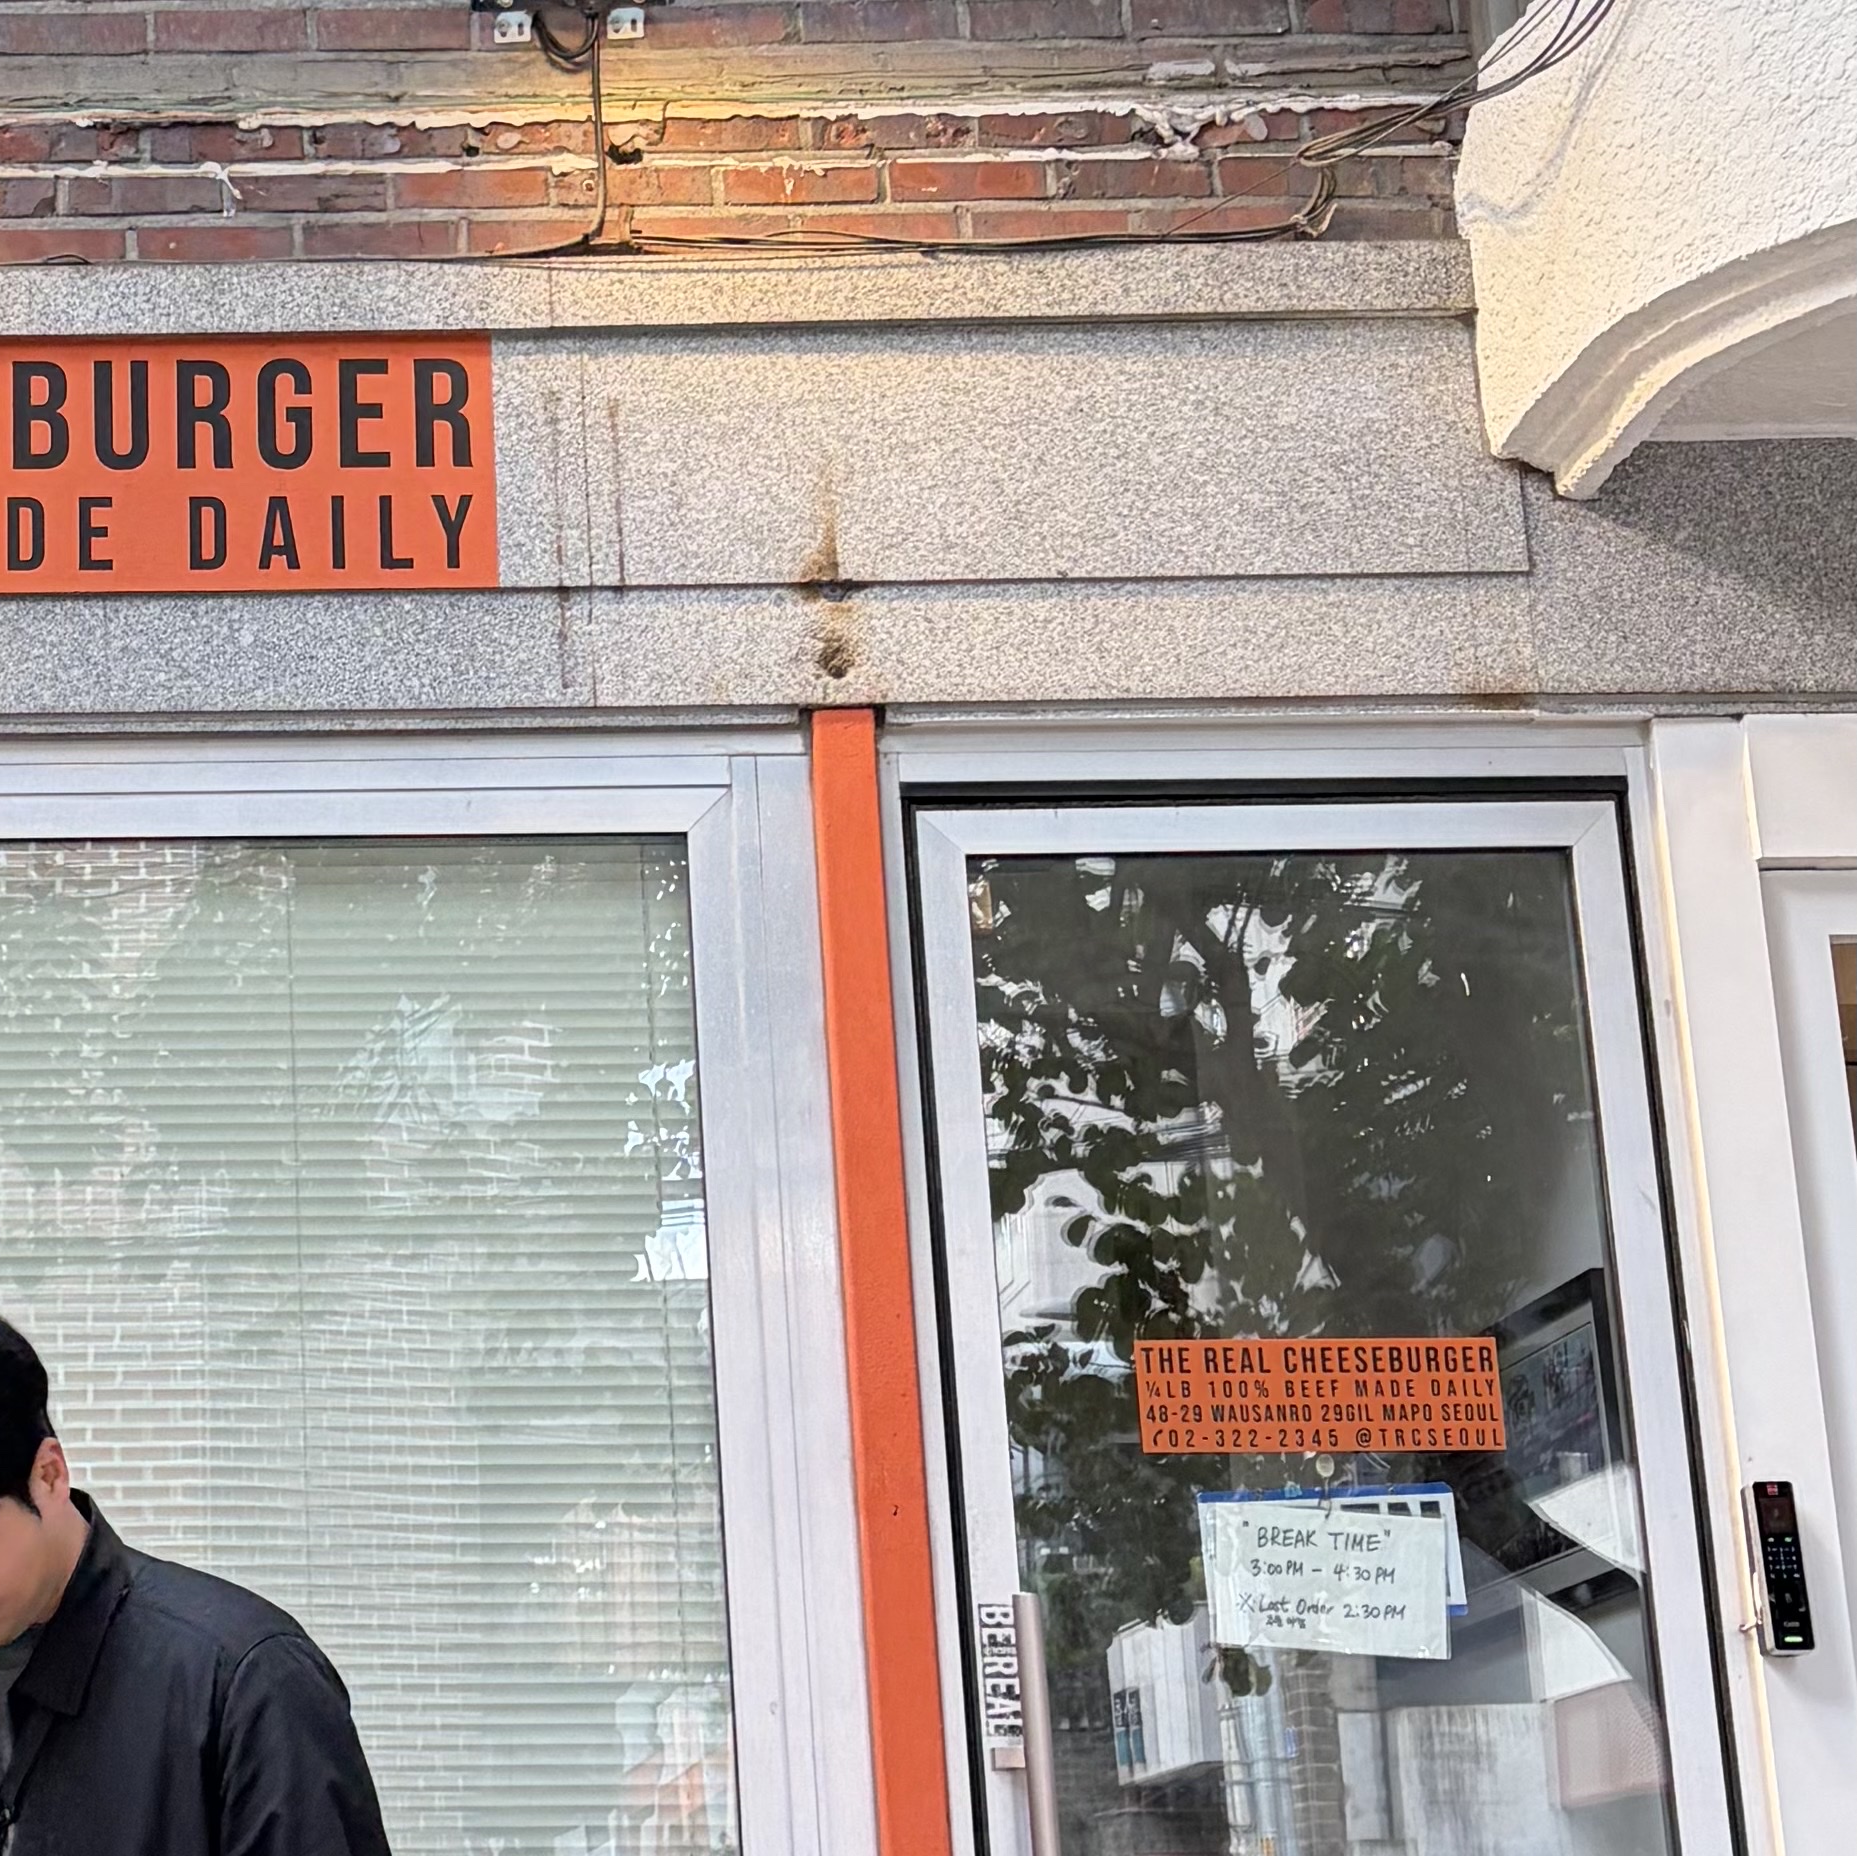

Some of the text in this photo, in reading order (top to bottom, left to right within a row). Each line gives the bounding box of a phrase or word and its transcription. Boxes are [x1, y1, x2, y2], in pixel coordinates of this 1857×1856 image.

[188, 494, 473, 572] DAILY
[1140, 1345, 1494, 1374] THE REAL CHEESEBURGER
[1207, 1379, 1269, 1398] 100%
[1285, 1378, 1339, 1398] BEEF
[1355, 1378, 1415, 1398] MADE
[1430, 1378, 1494, 1398] DAILY
[1146, 1403, 1499, 1423] 48-29 WAUSANRO 29GIL MAPO SEOUL
[1167, 1427, 1504, 1448] 02-322-2345 @TRCSEOUL
[1258, 1594, 1291, 1613] Last
[1295, 1597, 1335, 1615] Order
[980, 1605, 1024, 1736] BE REAL
